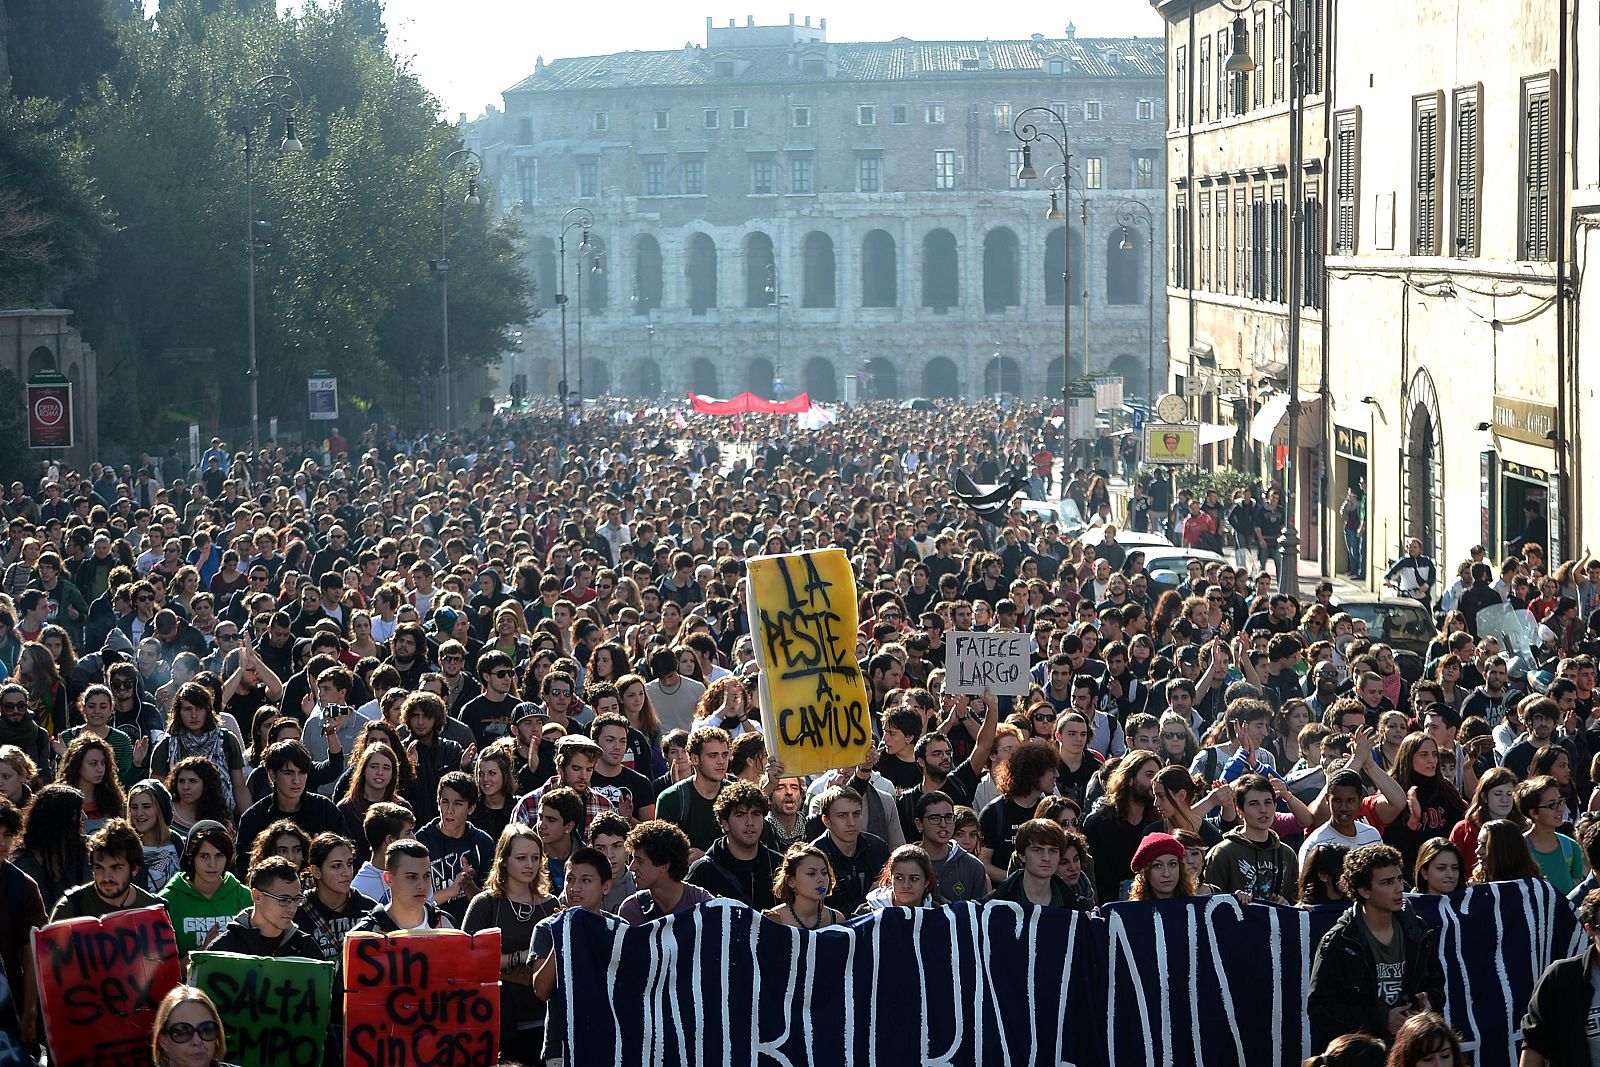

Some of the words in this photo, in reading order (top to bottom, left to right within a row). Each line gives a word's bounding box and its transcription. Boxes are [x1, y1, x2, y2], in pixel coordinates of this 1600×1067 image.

[1184, 375, 1238, 397] BAR
[776, 553, 833, 609] LA
[760, 609, 846, 671] PESTE
[956, 636, 1020, 658] FATECE
[958, 660, 1019, 687] LARGO
[779, 701, 866, 748] CAMUS
[42, 921, 177, 986] MIDDLE
[357, 940, 429, 988] Sin
[207, 968, 320, 1025] SALTA
[386, 986, 494, 1025] Curro
